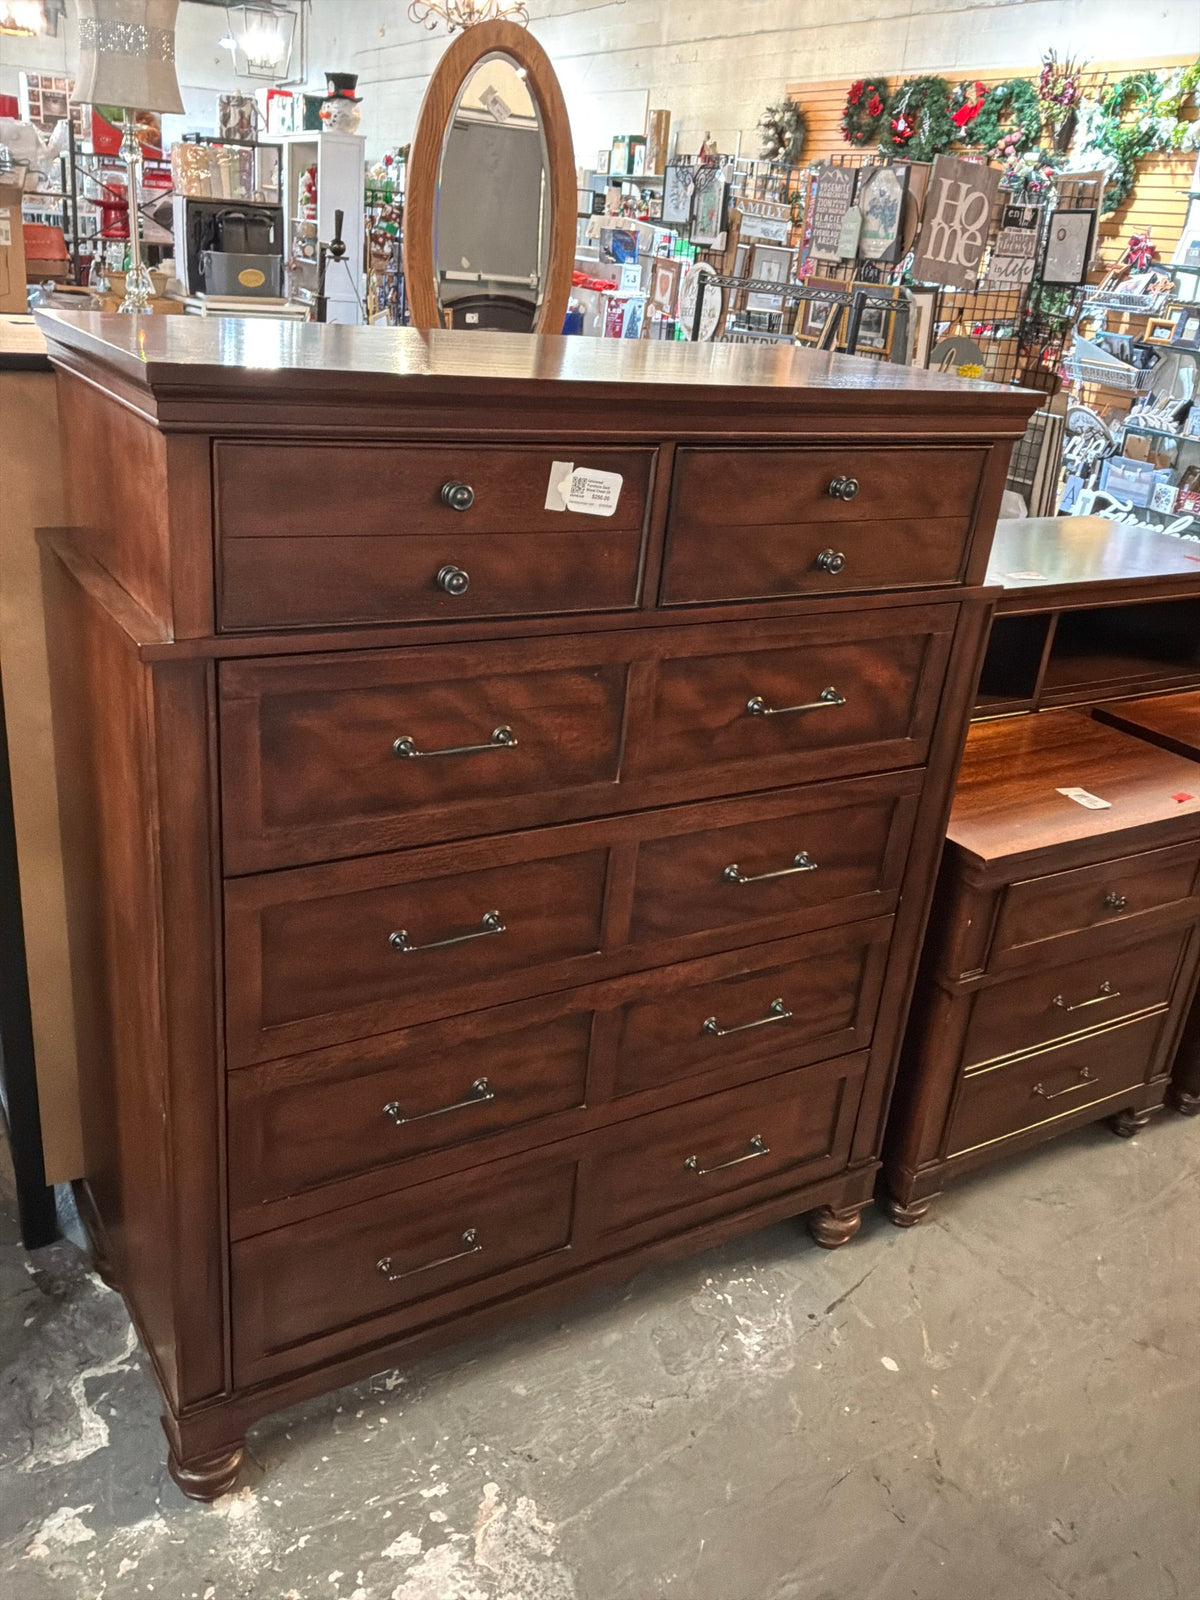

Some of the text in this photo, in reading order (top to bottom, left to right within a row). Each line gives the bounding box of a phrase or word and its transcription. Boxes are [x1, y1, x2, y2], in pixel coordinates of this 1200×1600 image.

[820, 182, 850, 193] YOSEMITE
[818, 198, 832, 207] ZION
[815, 213, 841, 223] GLACIE
[1008, 208, 1036, 223] enjy
[817, 237, 839, 246] ARCHE
[999, 257, 1033, 281] life
